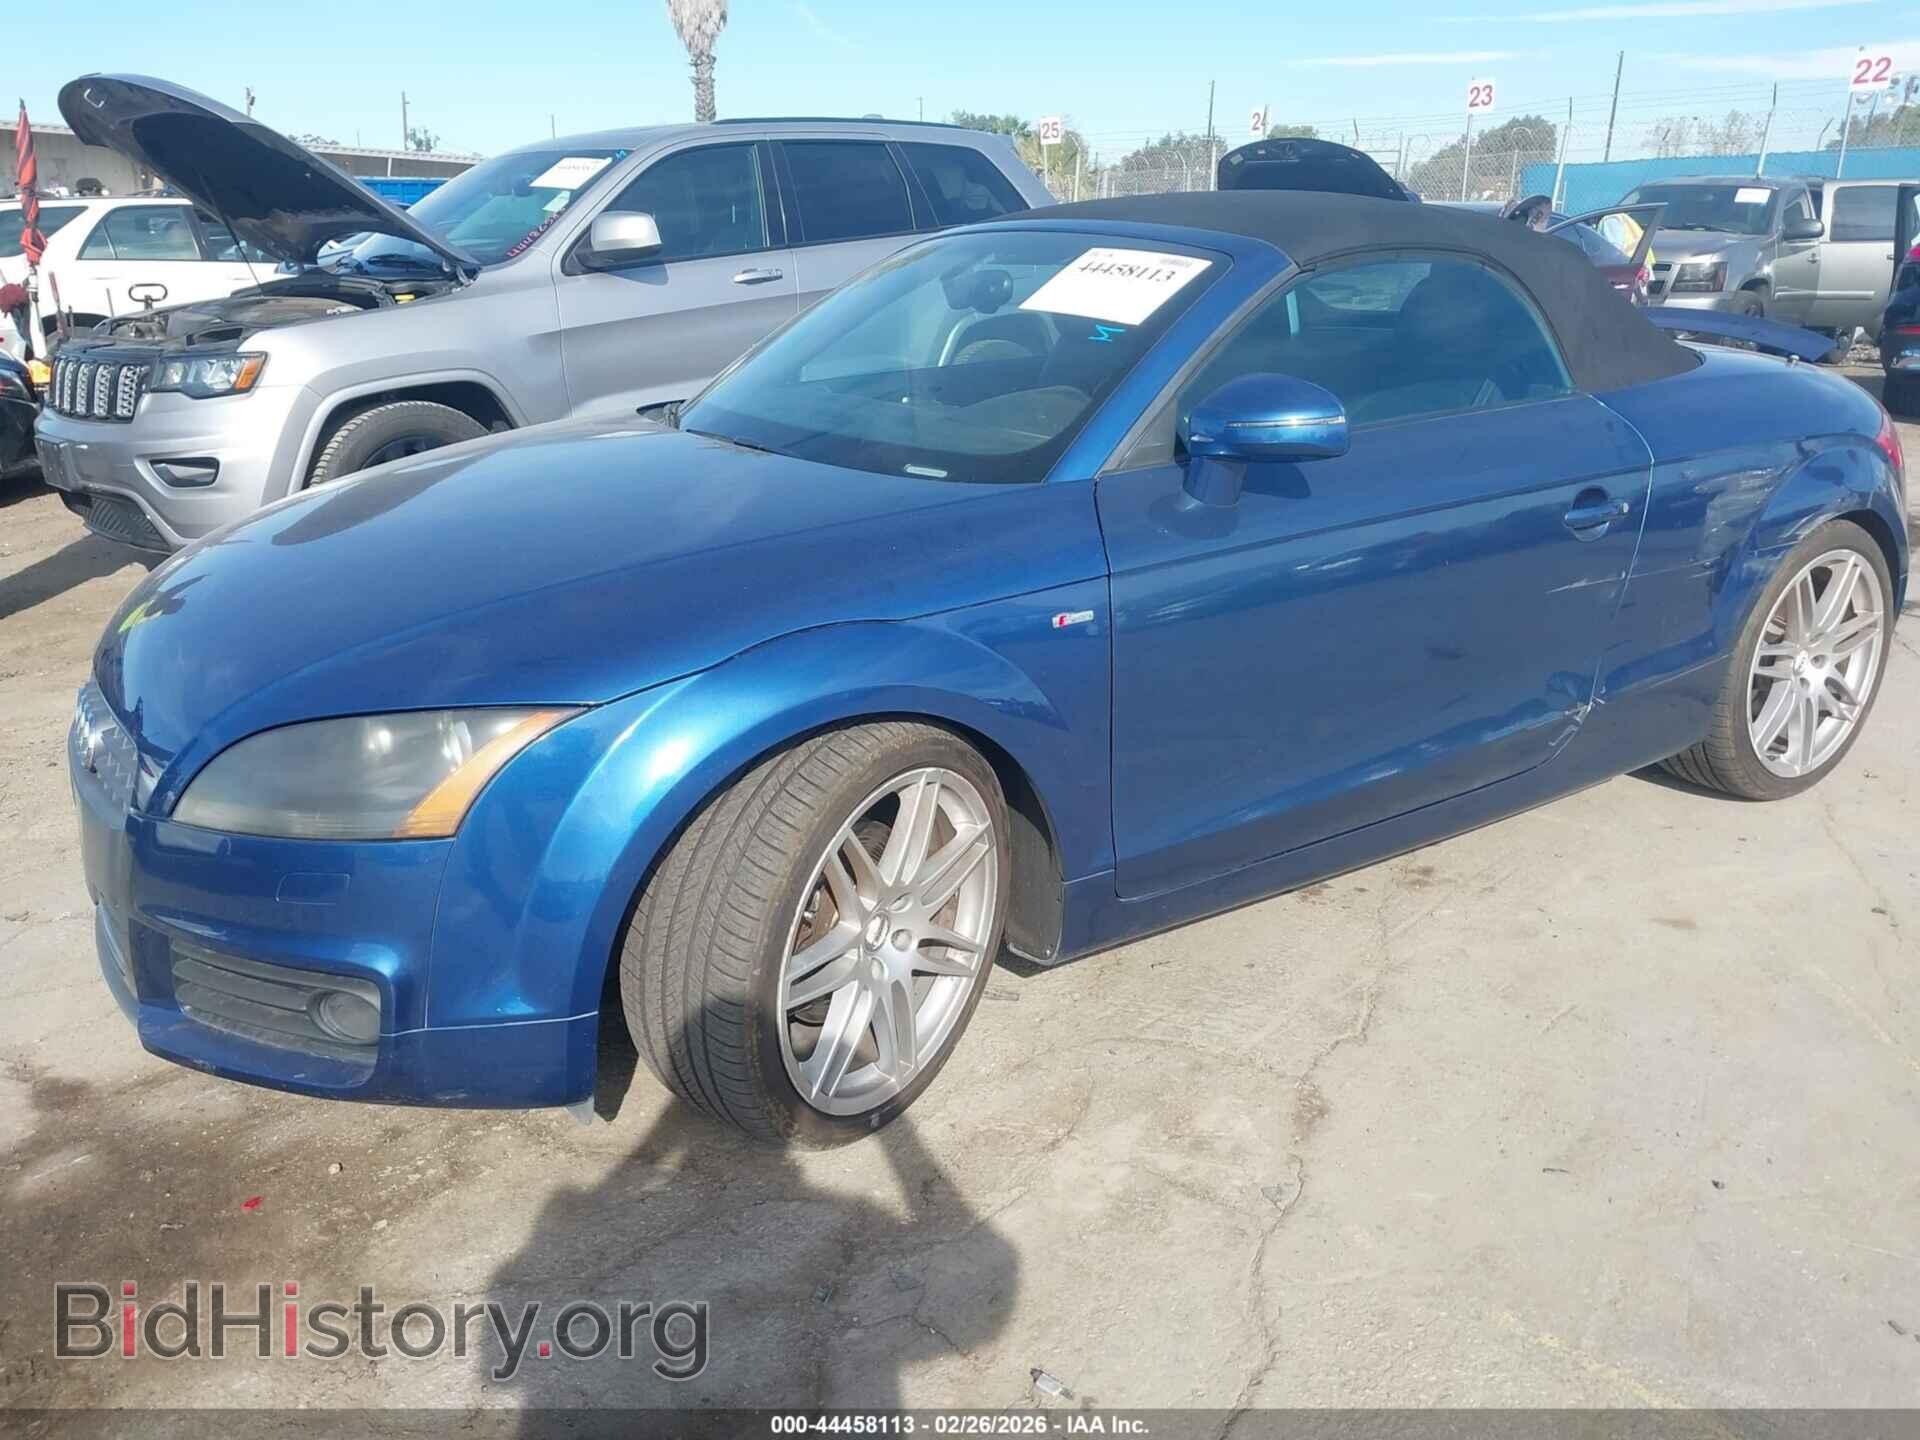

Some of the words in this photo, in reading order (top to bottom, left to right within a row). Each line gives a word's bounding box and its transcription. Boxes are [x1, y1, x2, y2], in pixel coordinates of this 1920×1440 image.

[1853, 56, 1892, 84] 22
[1468, 84, 1493, 107] 23
[1042, 121, 1060, 139] 25
[1078, 261, 1176, 282] 44458113
